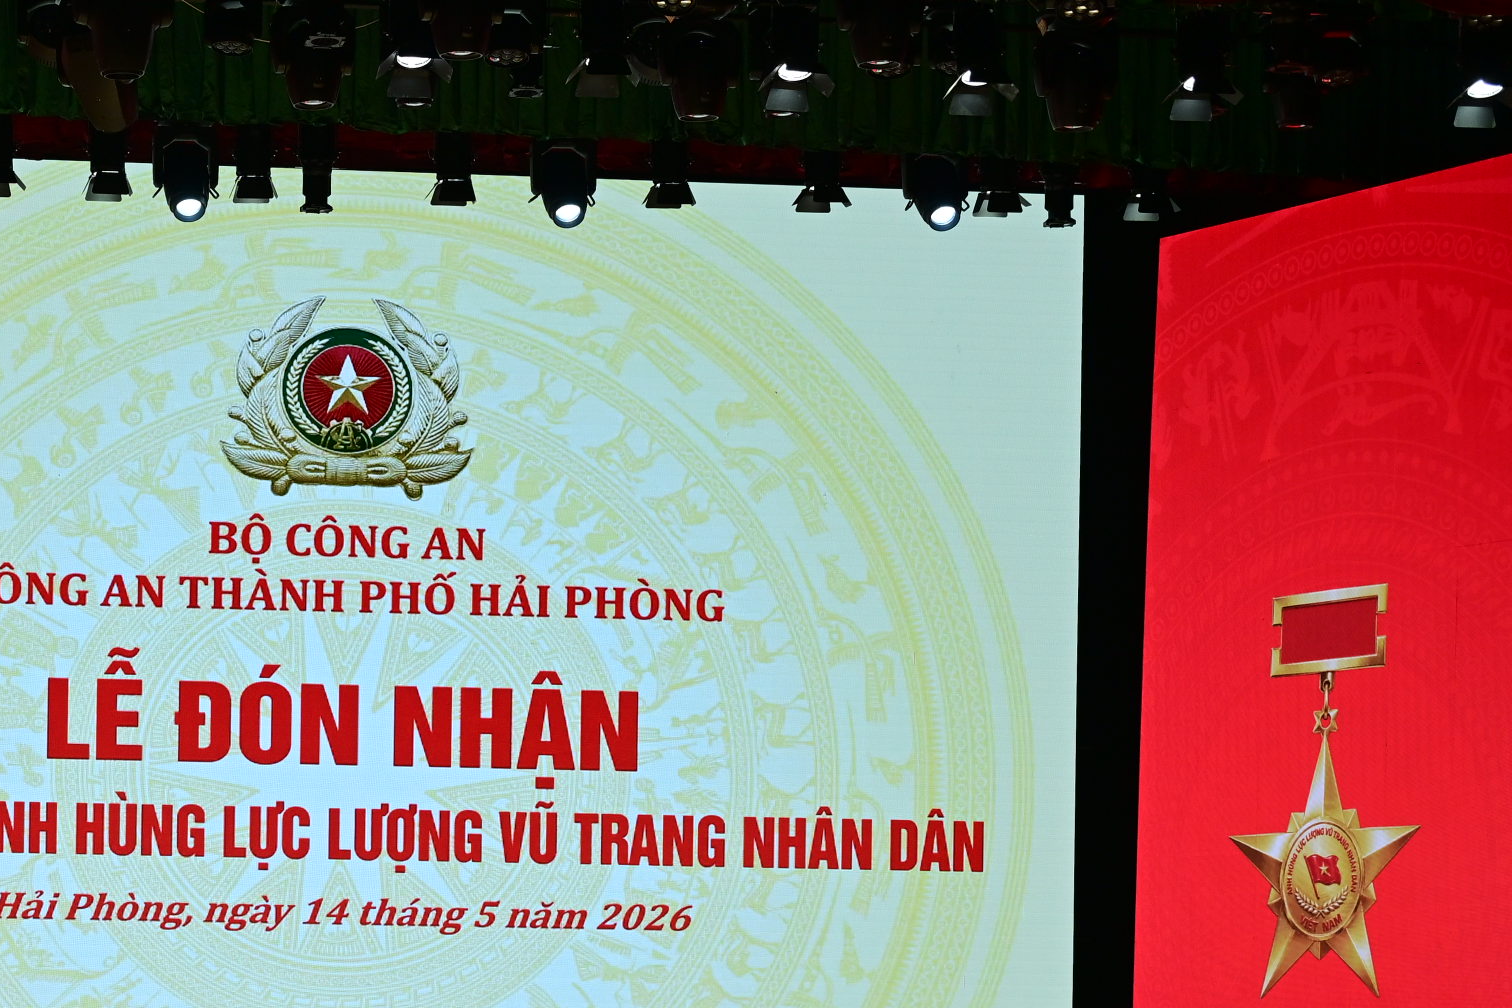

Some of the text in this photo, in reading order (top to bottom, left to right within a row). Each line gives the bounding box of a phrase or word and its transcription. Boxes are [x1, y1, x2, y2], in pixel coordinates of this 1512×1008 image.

[211, 513, 485, 563] BỘ CÔNG AN
[102, 575, 165, 607] AN
[180, 568, 344, 612] THÀNH
[361, 572, 456, 614] PHỐ
[472, 575, 550, 617] HẢI
[567, 578, 724, 621] PHÒNG
[48, 647, 638, 789] LỄ ĐÓN NHẬN
[76, 792, 205, 857] HÙNG
[224, 801, 310, 869] LỰC
[329, 803, 482, 872] LƯỢNG
[500, 801, 557, 864] VŨ
[575, 813, 725, 866] TRANG
[744, 806, 872, 869] NHÂN
[891, 808, 984, 872] DÂN
[67, 893, 192, 929] Phòng,
[206, 896, 295, 932] ngày
[308, 898, 349, 925] 14
[360, 898, 468, 935] tháng
[475, 900, 500, 927] 5
[508, 903, 587, 929] năm
[598, 904, 692, 931] 2026
[1322, 914, 1342, 932] NAM
